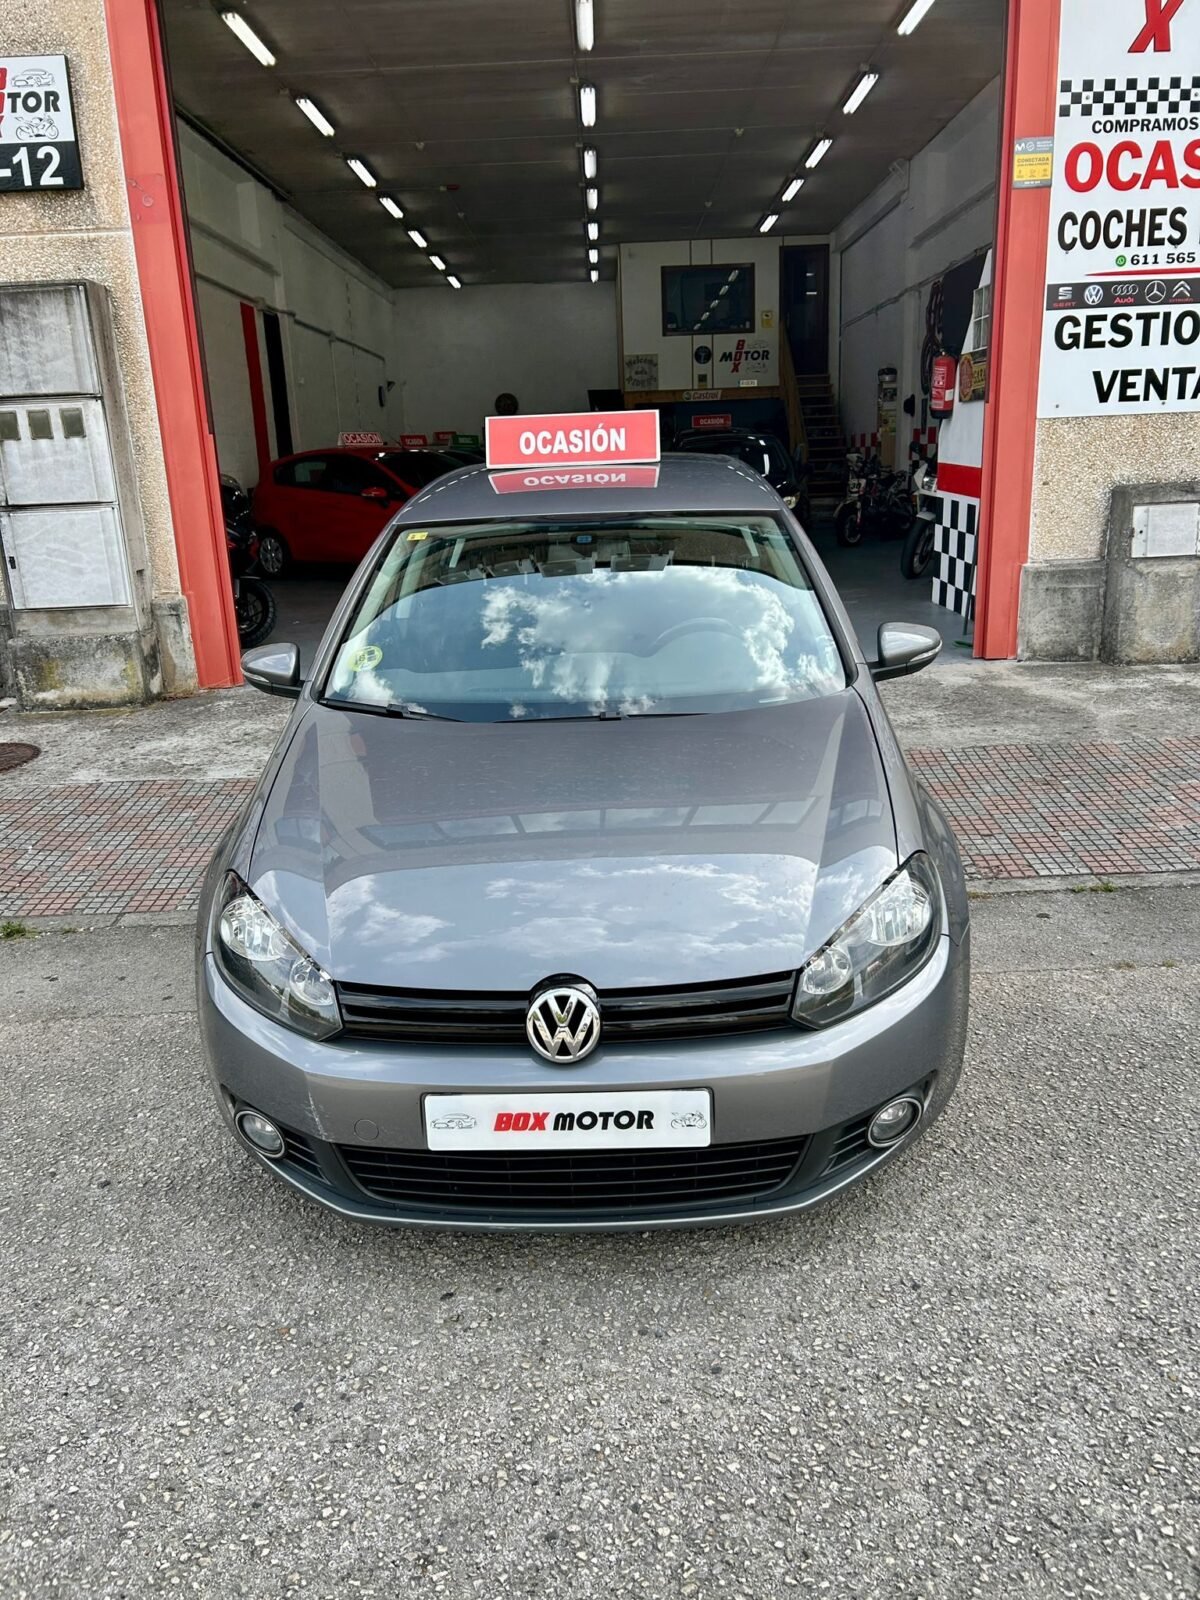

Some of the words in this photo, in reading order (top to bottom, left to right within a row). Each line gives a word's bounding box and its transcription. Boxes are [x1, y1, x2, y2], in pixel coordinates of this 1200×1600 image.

[1091, 117, 1200, 134] COMPRAMOS
[1057, 206, 1188, 251] COCHES
[1130, 253, 1159, 266] 611
[1166, 252, 1196, 265] 565
[1114, 296, 1135, 304] Audi
[1054, 310, 1200, 351] GESTIO
[692, 391, 719, 400] Castrol
[519, 423, 626, 456] OCASIÓN
[493, 1112, 551, 1132] BOX
[552, 1110, 655, 1132] MOTOR
